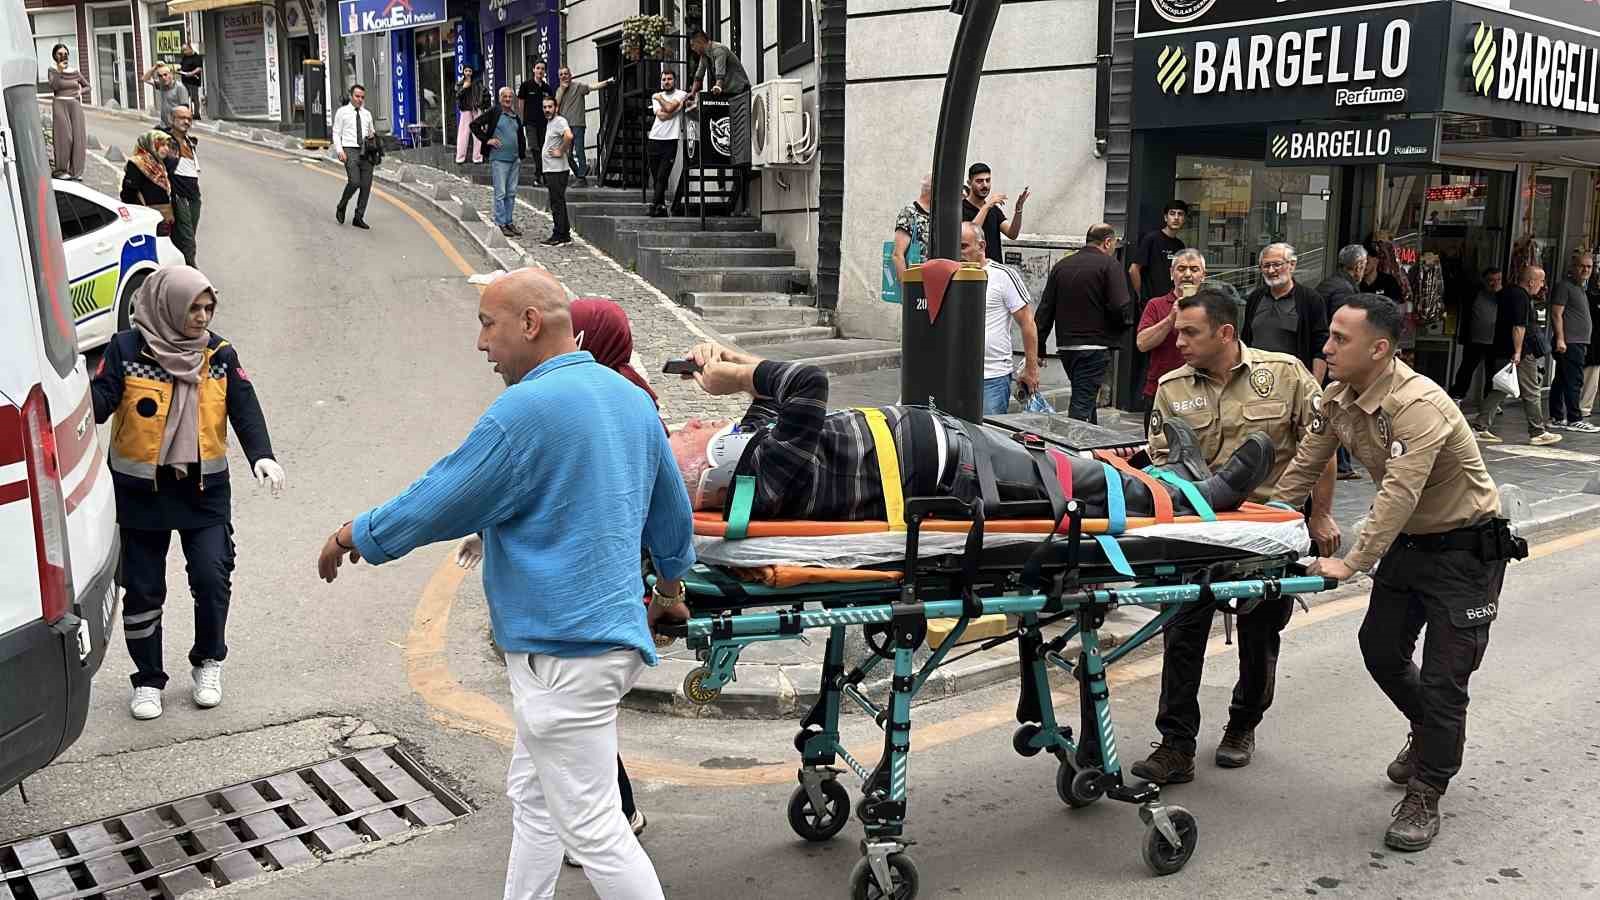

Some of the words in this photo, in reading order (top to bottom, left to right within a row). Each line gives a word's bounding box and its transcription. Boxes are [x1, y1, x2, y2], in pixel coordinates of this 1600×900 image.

[1193, 19, 1411, 94] BARGELLO
[1335, 86, 1406, 106] Perfume
[1290, 128, 1391, 159] BARGELLO
